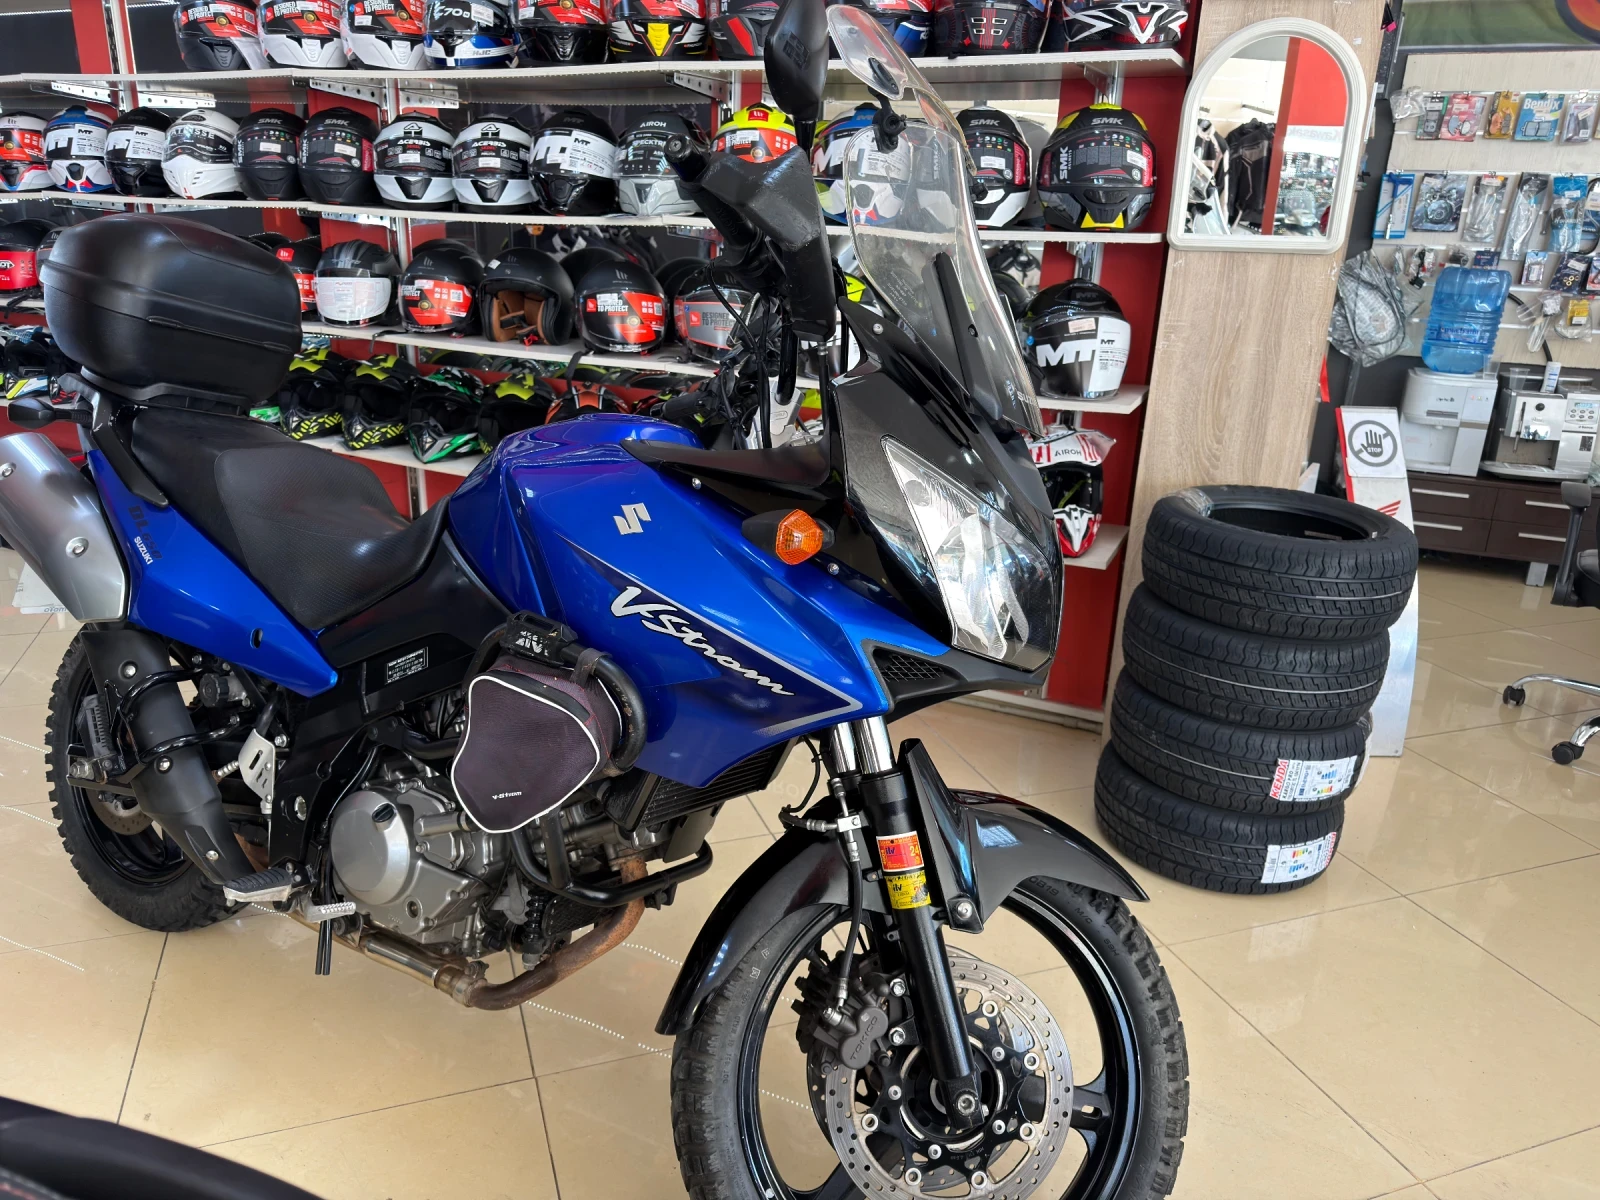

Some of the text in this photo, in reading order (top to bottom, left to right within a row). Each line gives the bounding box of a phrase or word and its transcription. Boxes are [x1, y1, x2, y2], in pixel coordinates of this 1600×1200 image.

[371, 3, 394, 11] PROTECT
[1524, 98, 1560, 110] Bendix
[323, 118, 350, 126] SMK
[639, 120, 667, 128] AIROH
[969, 119, 1000, 127] SMK
[1091, 117, 1124, 125] SMK
[397, 139, 431, 147] ACERBIS
[573, 138, 591, 146] MT
[1059, 146, 1068, 180] SMK
[1036, 338, 1097, 368] MT
[1054, 448, 1082, 457] AIROH
[134, 536, 154, 565] SUZUKI
[1270, 760, 1289, 799] KENDA
[910, 844, 920, 857] 24
[1074, 907, 1093, 925] M/C
[849, 1015, 878, 1060] TOKICO
